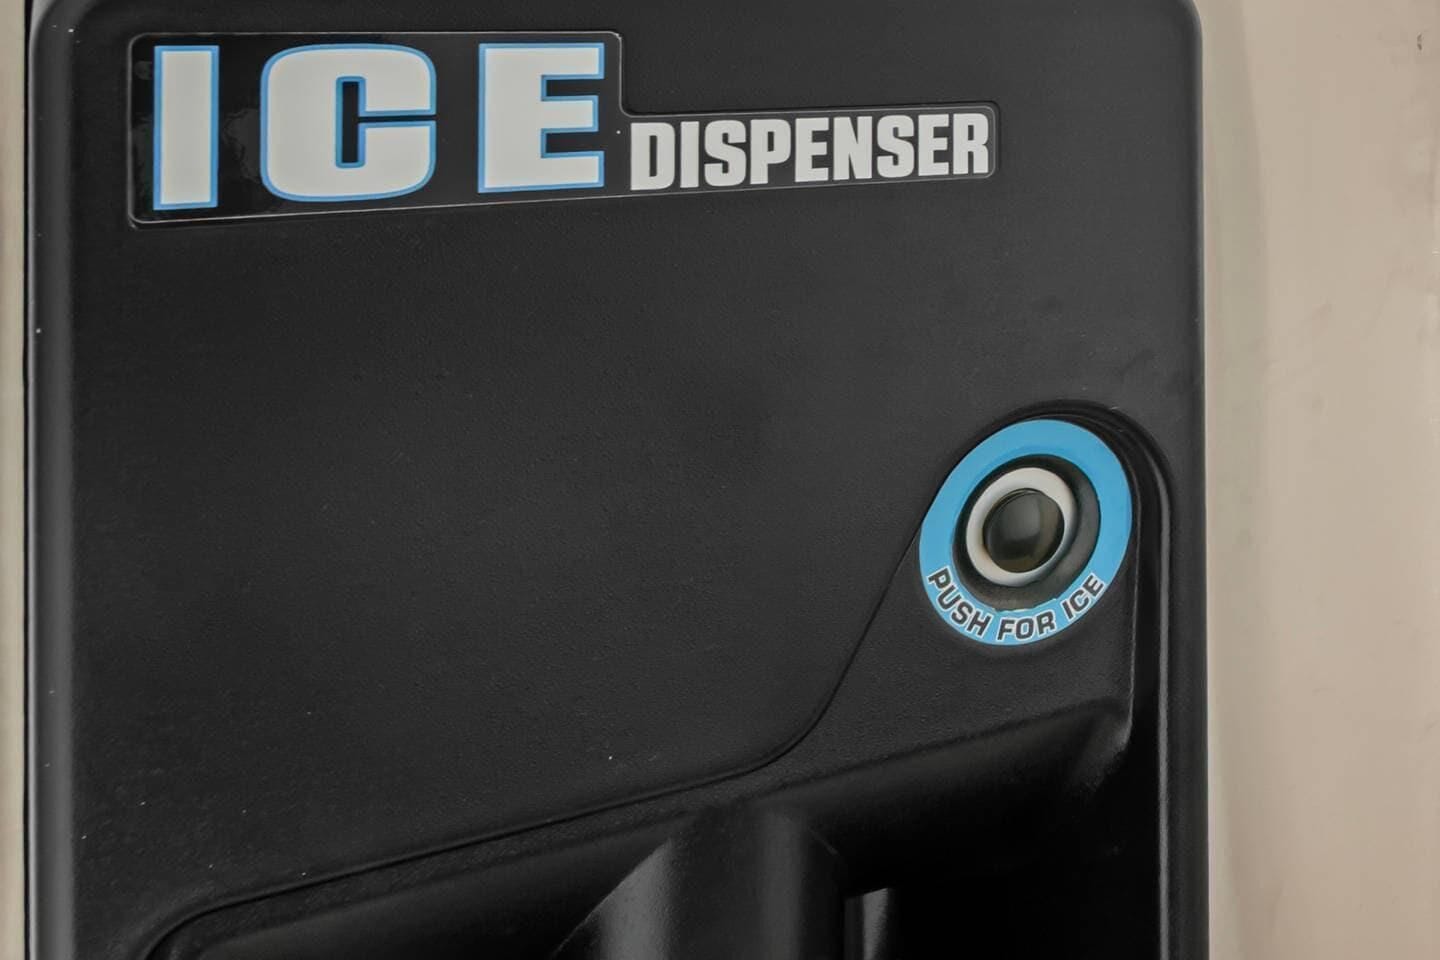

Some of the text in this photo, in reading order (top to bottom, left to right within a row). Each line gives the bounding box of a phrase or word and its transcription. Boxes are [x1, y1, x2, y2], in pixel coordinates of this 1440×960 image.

[153, 42, 990, 211] ICE DISPENSER
[927, 567, 1105, 641] PUSH FOR ICE
